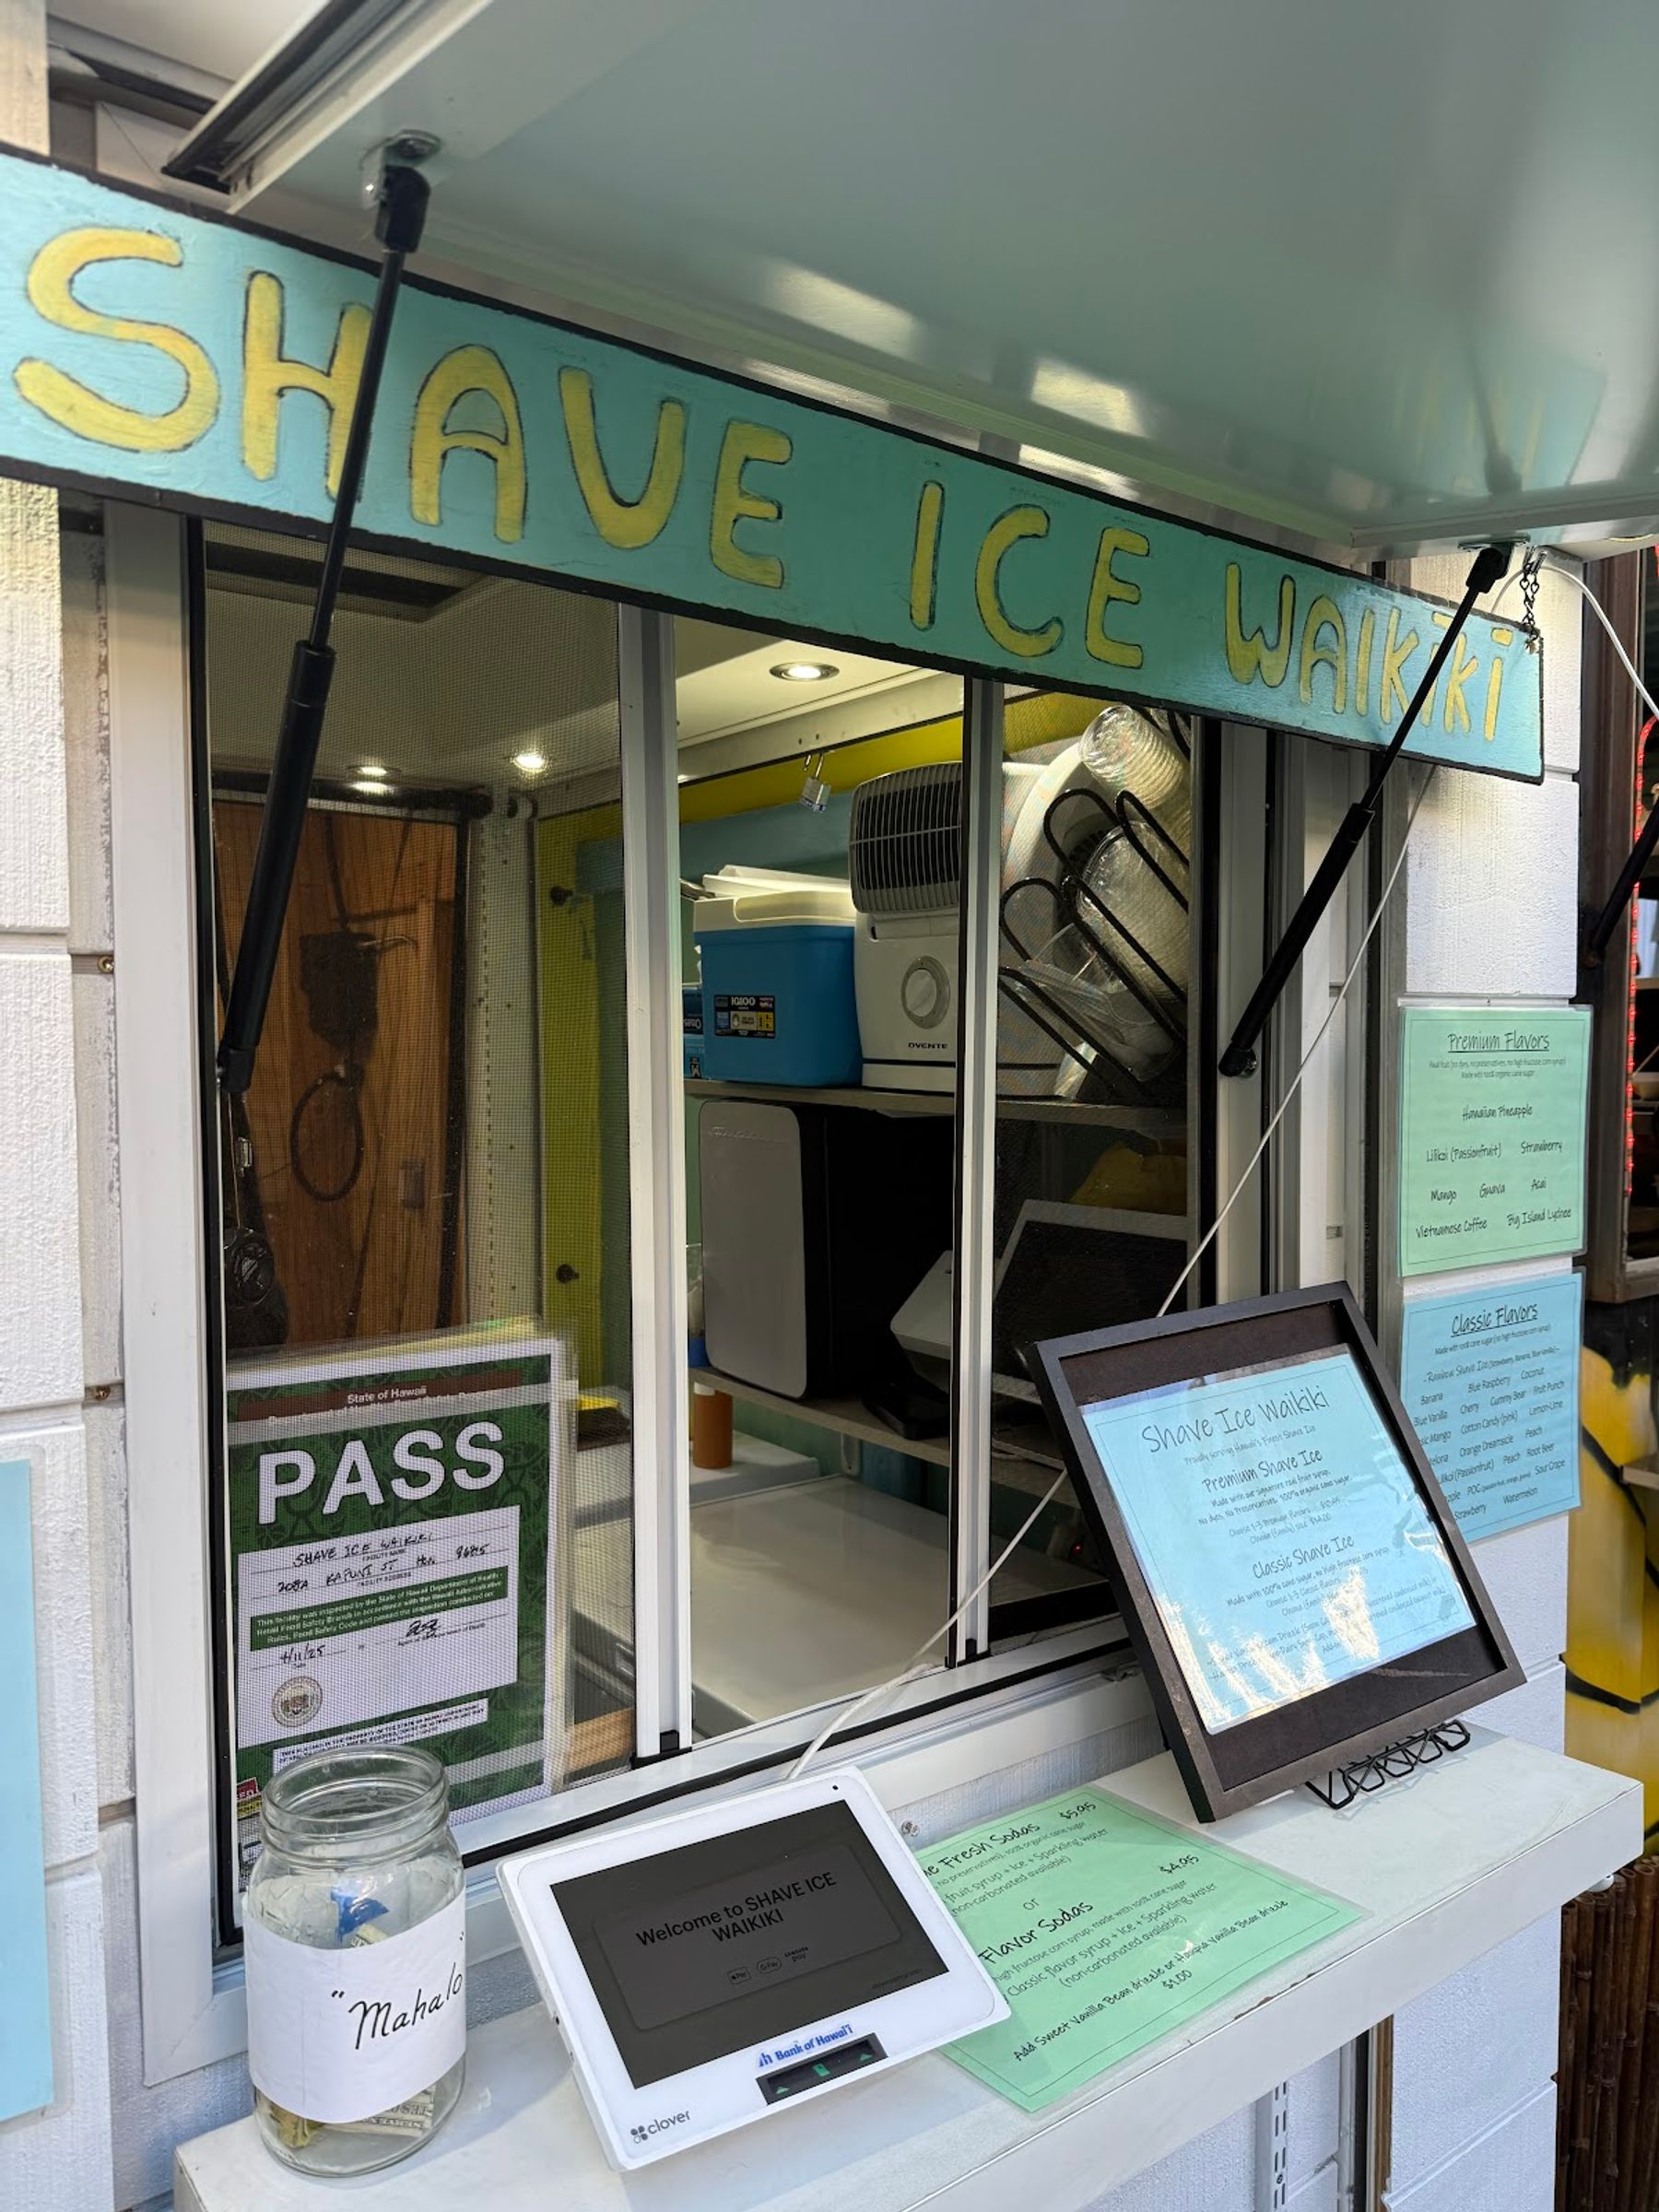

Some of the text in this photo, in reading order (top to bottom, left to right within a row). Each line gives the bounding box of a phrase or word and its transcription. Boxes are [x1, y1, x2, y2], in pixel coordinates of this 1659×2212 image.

[13, 226, 794, 590] SHAVE
[909, 479, 1151, 669] ICE
[1447, 1029, 1550, 1051] Premium Flavors
[1463, 1103, 1534, 1121] Hawaiian Pineapple
[1521, 1139, 1563, 1154] Strawberry
[1430, 1177, 1547, 1205] Mango Guava Acai
[1416, 1222, 1463, 1239] Vietnamese
[1464, 1217, 1488, 1232] Coffee
[1506, 1213, 1521, 1230] Big
[1522, 1208, 1546, 1225] Island
[1452, 1303, 1539, 1335] Classic Flavors
[347, 1385, 428, 1405] State of Hawaii
[1420, 1367, 1545, 1406] Banana Blue Raspberry Coconut
[1142, 1385, 1330, 1453] Shave Ice Waikiki
[1414, 1417, 1428, 1428] Blue
[1429, 1410, 1448, 1424] Vanilla
[1460, 1402, 1479, 1416] Cherry
[1512, 1390, 1527, 1402] Bear
[1533, 1383, 1547, 1395] Fruit
[1547, 1381, 1565, 1393] Punch
[1430, 1430, 1452, 1443] Mango
[1461, 1421, 1482, 1435] Cotton
[1482, 1416, 1500, 1430] Candy
[1501, 1410, 1519, 1425] (pink)
[1460, 1443, 1483, 1459] Orange
[1525, 1426, 1543, 1438] Peach
[1183, 1453, 1210, 1466] Proudly
[1263, 1434, 1284, 1446] Finest
[1283, 1429, 1303, 1441] Shave
[1303, 1425, 1316, 1435] Ice
[1503, 1453, 1521, 1465] Peach
[1526, 1448, 1541, 1459] Root
[1542, 1442, 1555, 1453] Beer
[258, 1421, 505, 1524] PASS
[1202, 1448, 1324, 1492] Premium Shave Ice
[1535, 1465, 1549, 1476] Sour
[1549, 1459, 1565, 1471] Grape
[1211, 1499, 1228, 1508] Made
[1230, 1494, 1245, 1504] with
[1279, 1490, 1300, 1502] 100%
[1453, 1487, 1538, 1521] Strawberry Watermelon
[292, 1548, 337, 1569] SHAVE
[344, 1542, 371, 1558] ICE
[1253, 1535, 1355, 1580] Classic Shave Ice
[1227, 1596, 1245, 1606] Made
[1246, 1590, 1263, 1601] with
[1263, 1583, 1282, 1596] 100%
[1282, 1579, 1296, 1588] cane
[938, 1801, 1097, 1869] Fresh Sodas $5.95
[938, 1877, 949, 1887] no
[945, 1827, 1109, 1904] fruit syrup Ice Sparkling water
[1028, 1856, 1072, 1877] available)
[636, 1872, 837, 1947] Welcome to SHAVE ICE
[712, 1908, 784, 1942] WAIKIKI
[978, 1853, 1199, 1965] Flavor Sodas $4.95
[1006, 1883, 1218, 1997] Classic flavor syrup Ice Sparkling water
[1048, 1942, 1068, 1953] corn
[1092, 1913, 1115, 1930] made
[1114, 1906, 1134, 1918] with
[1059, 1915, 1188, 1988] (non-carbonated available)
[1014, 2041, 1037, 2062] Add
[1034, 2022, 1072, 2046] Sweet
[1069, 2002, 1106, 2025] Vanilla
[1102, 1988, 1134, 2006] Bean
[1130, 1969, 1165, 1991] drizzle
[1165, 1961, 1176, 1971] or
[1208, 1924, 1239, 1945] Vanilla
[1235, 1913, 1260, 1928] Bean
[1259, 1900, 1288, 1918] drizzle
[1162, 1970, 1193, 1990] $1.00
[774, 2043, 805, 2062] Bank
[804, 2037, 816, 2052] of
[647, 2111, 690, 2135] clover
